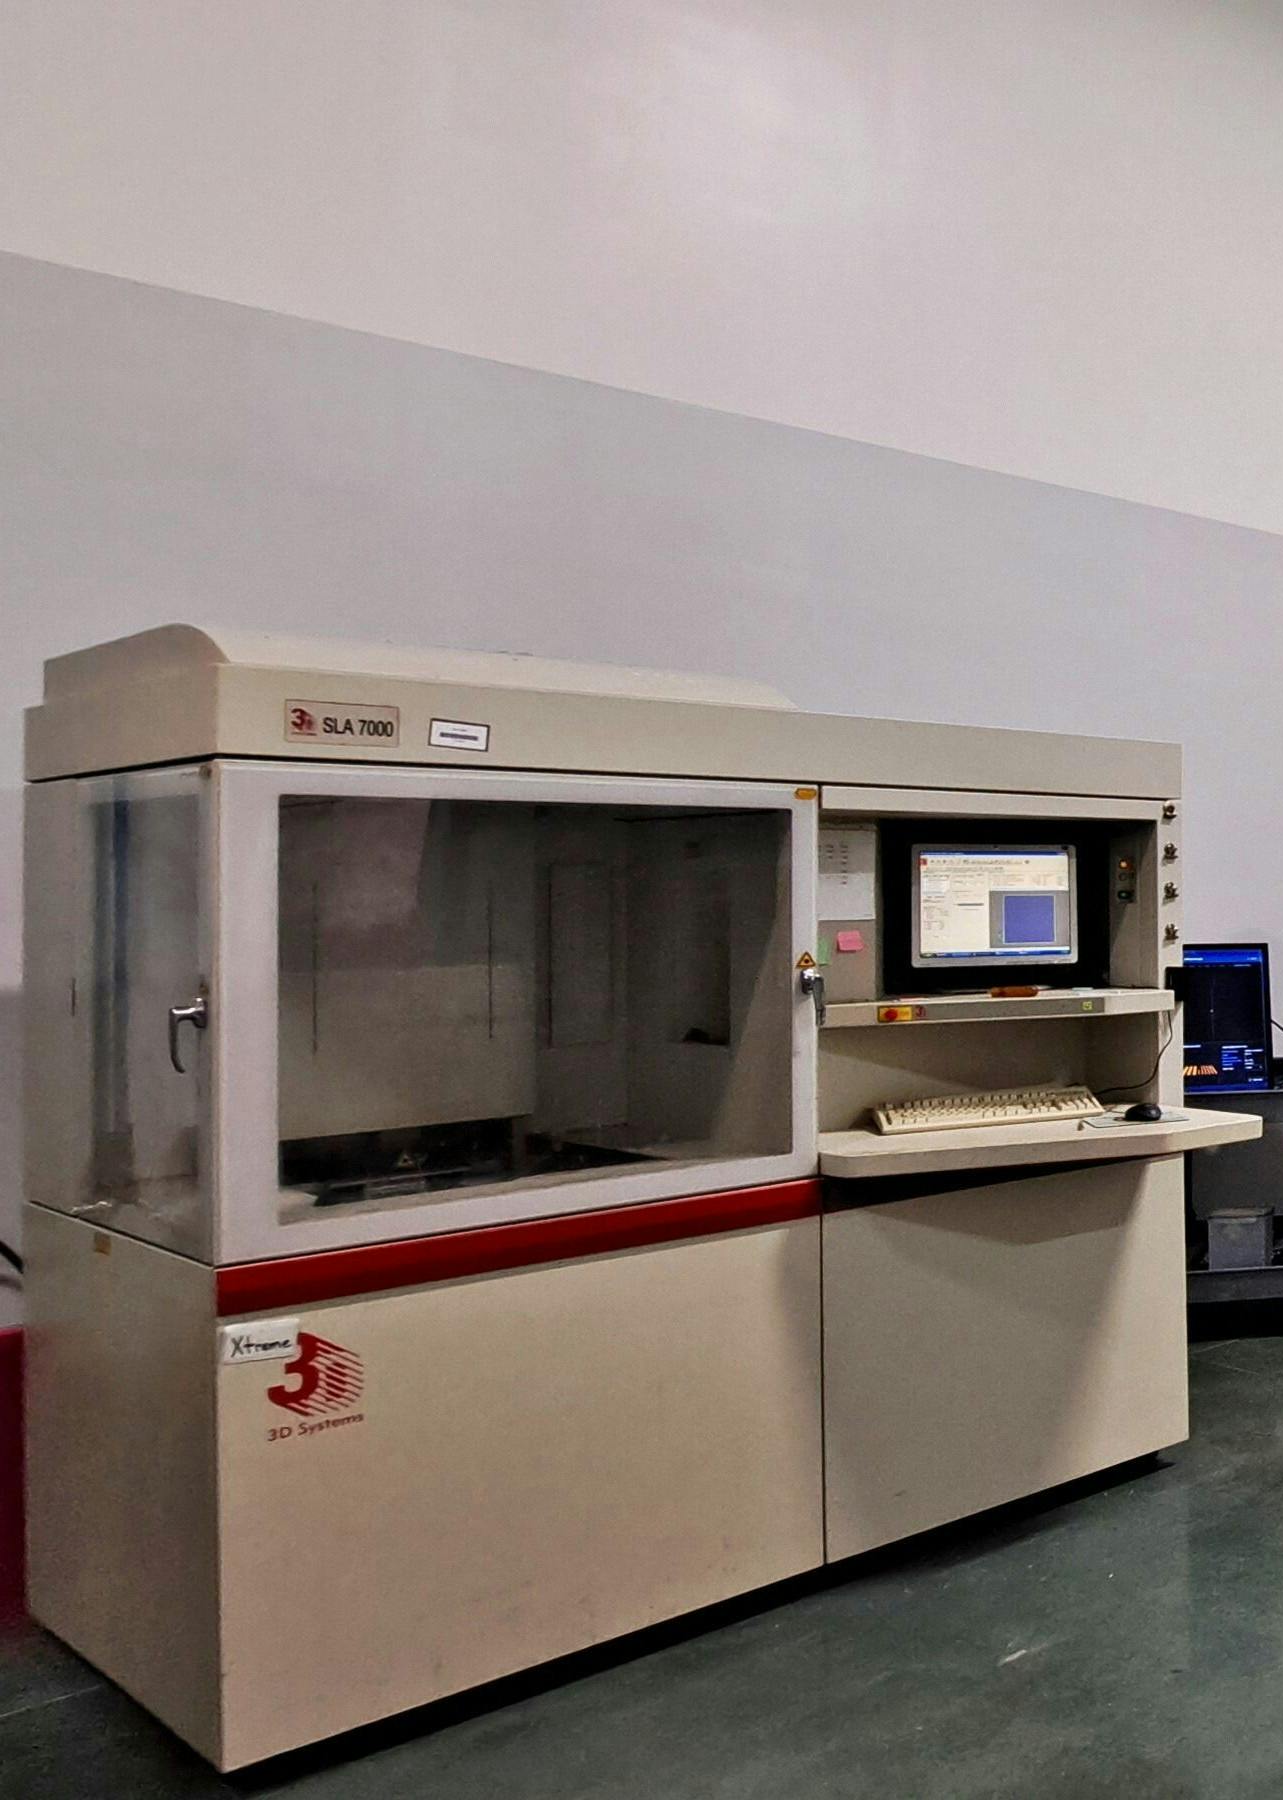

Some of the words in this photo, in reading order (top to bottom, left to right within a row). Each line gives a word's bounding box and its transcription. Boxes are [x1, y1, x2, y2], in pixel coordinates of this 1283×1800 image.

[323, 717, 354, 735] SLA
[358, 719, 394, 738] 7000
[231, 1335, 292, 1358] Xtreme
[267, 1426, 293, 1442] 3D
[298, 1413, 365, 1436] Systems
